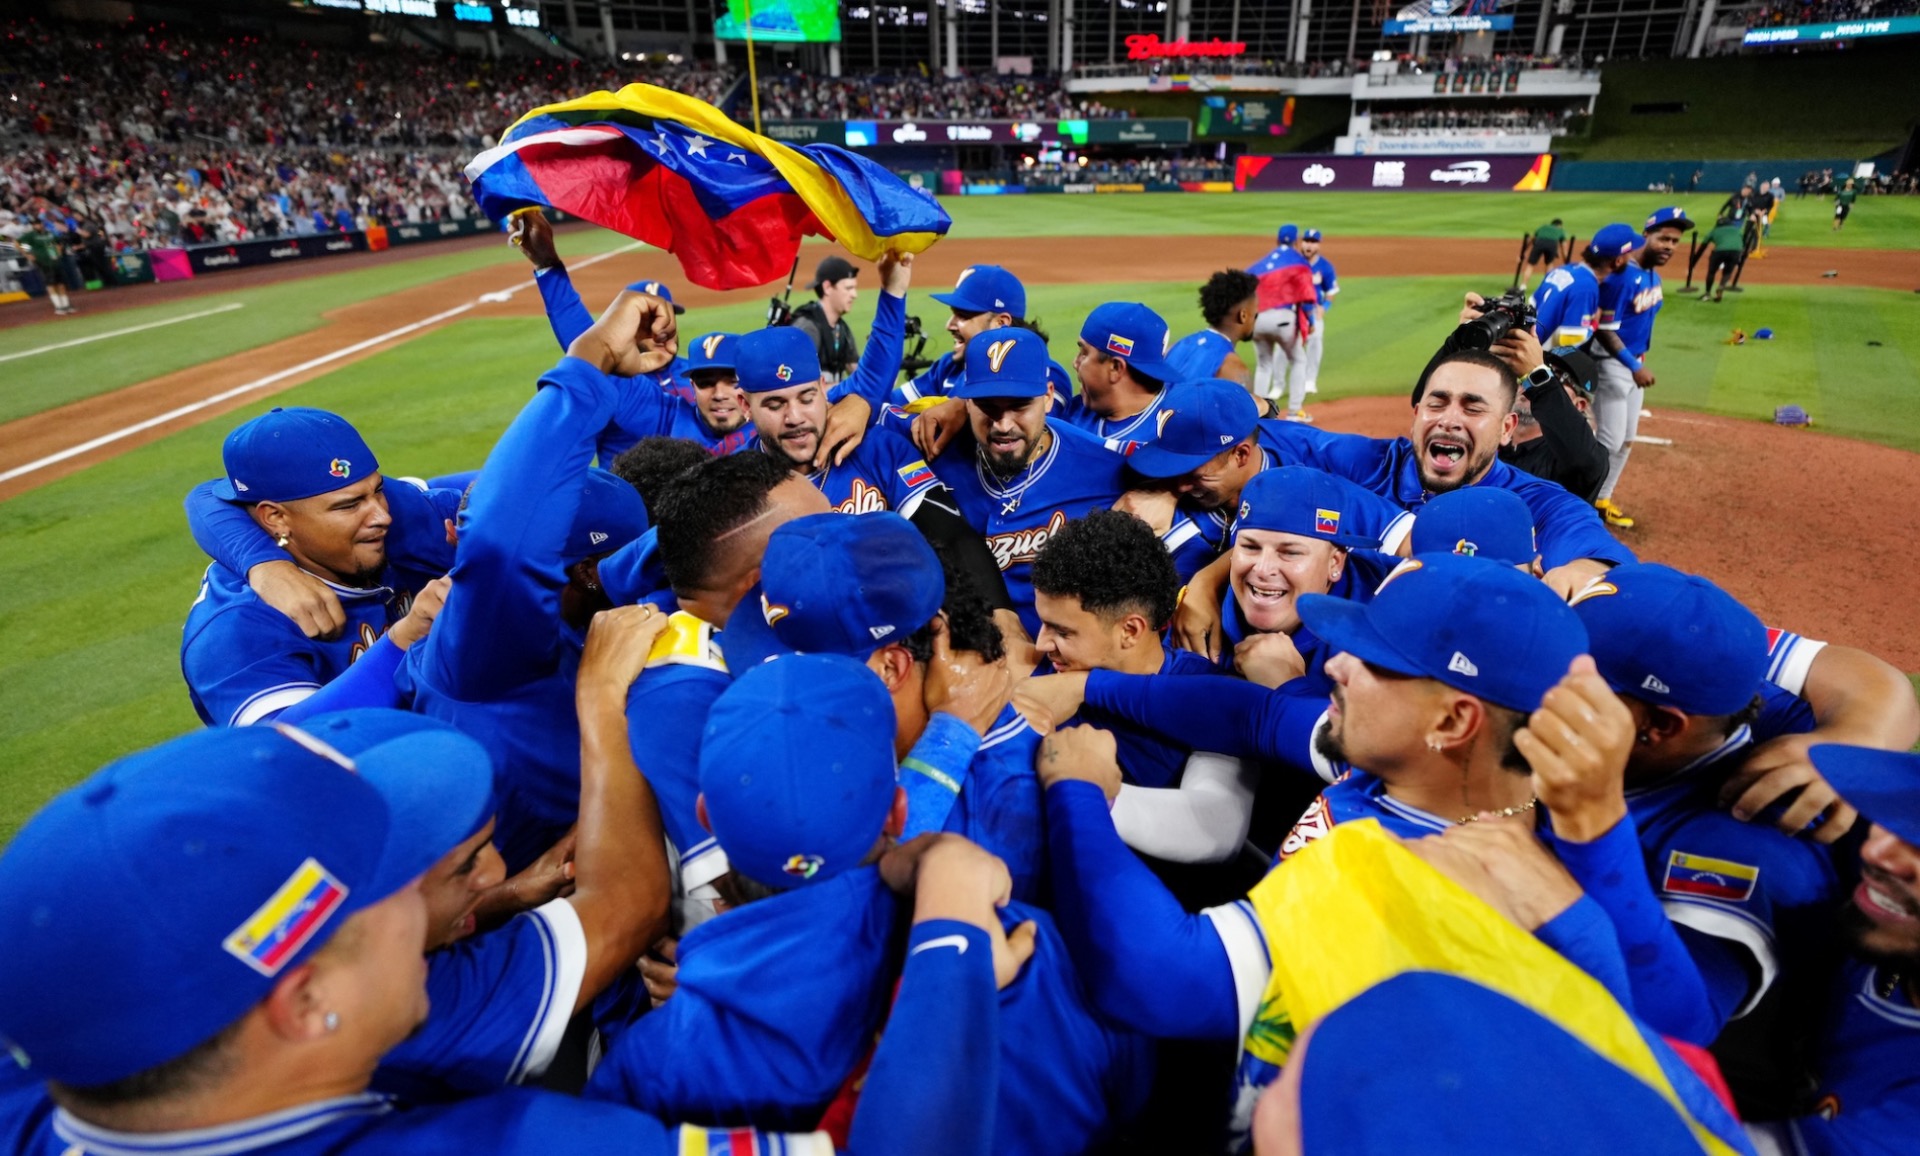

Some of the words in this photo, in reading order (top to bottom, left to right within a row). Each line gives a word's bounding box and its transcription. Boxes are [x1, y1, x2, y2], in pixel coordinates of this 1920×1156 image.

[1745, 31, 1771, 43] PITCH
[1770, 29, 1799, 41] SPEED
[1836, 23, 1865, 36] PITCH
[1865, 20, 1891, 34] TYPE
[1125, 33, 1247, 59] Budweiser
[768, 125, 818, 140] DIRECTV
[702, 334, 725, 360] V
[986, 339, 1016, 373] V
[1156, 408, 1175, 439] V
